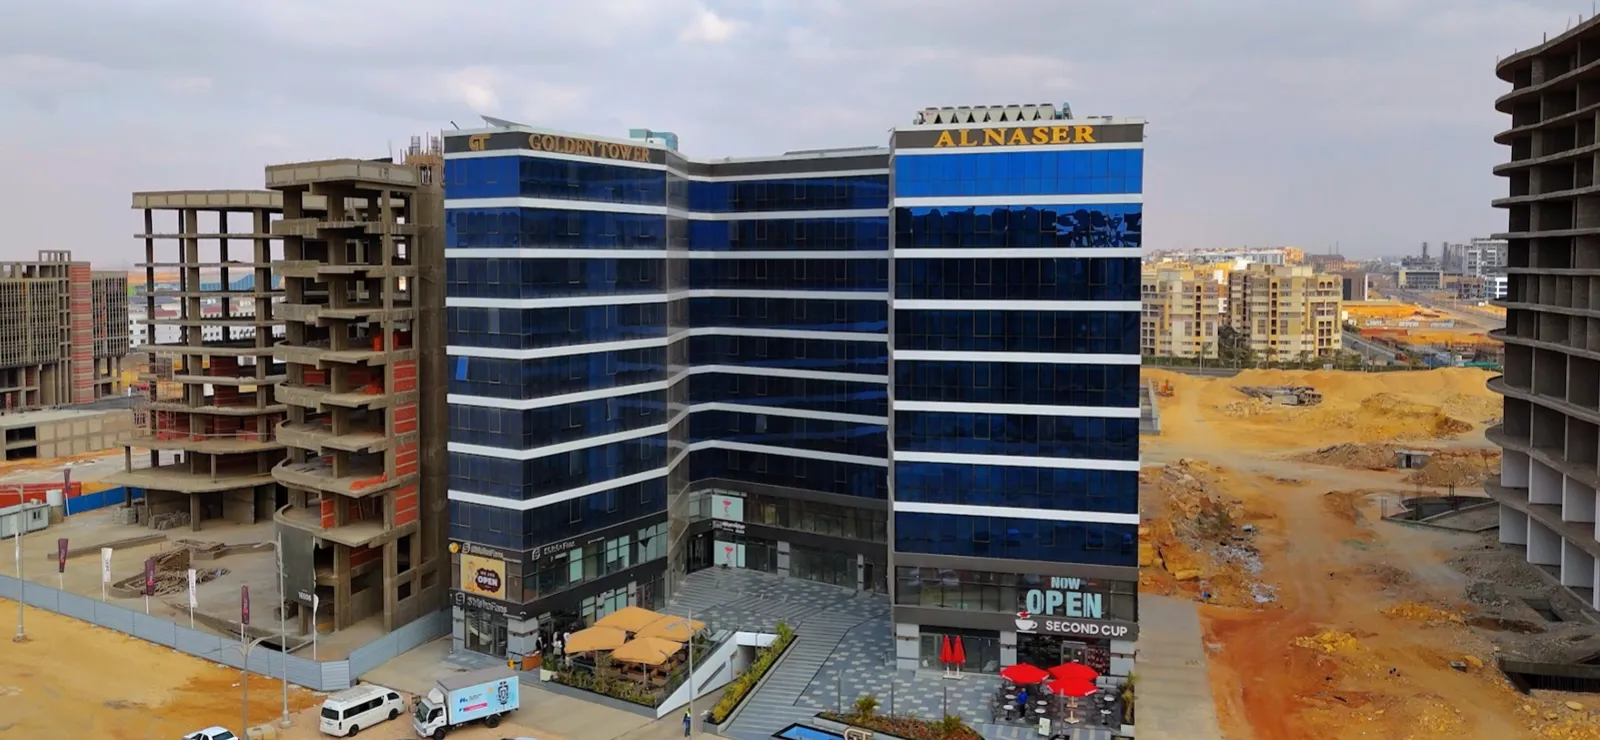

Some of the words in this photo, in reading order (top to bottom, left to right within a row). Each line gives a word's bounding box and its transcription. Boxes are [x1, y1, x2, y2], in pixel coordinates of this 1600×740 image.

[468, 133, 491, 151] GT
[934, 129, 977, 148] AL
[983, 125, 1096, 146] NASER
[528, 133, 594, 155] GOLDEN
[598, 141, 650, 163] TOWER
[477, 575, 498, 587] OPEN
[1051, 576, 1081, 590] NOW
[1026, 588, 1102, 619] OPEN
[1045, 620, 1099, 635] SECOND
[1101, 625, 1128, 637] CUP
